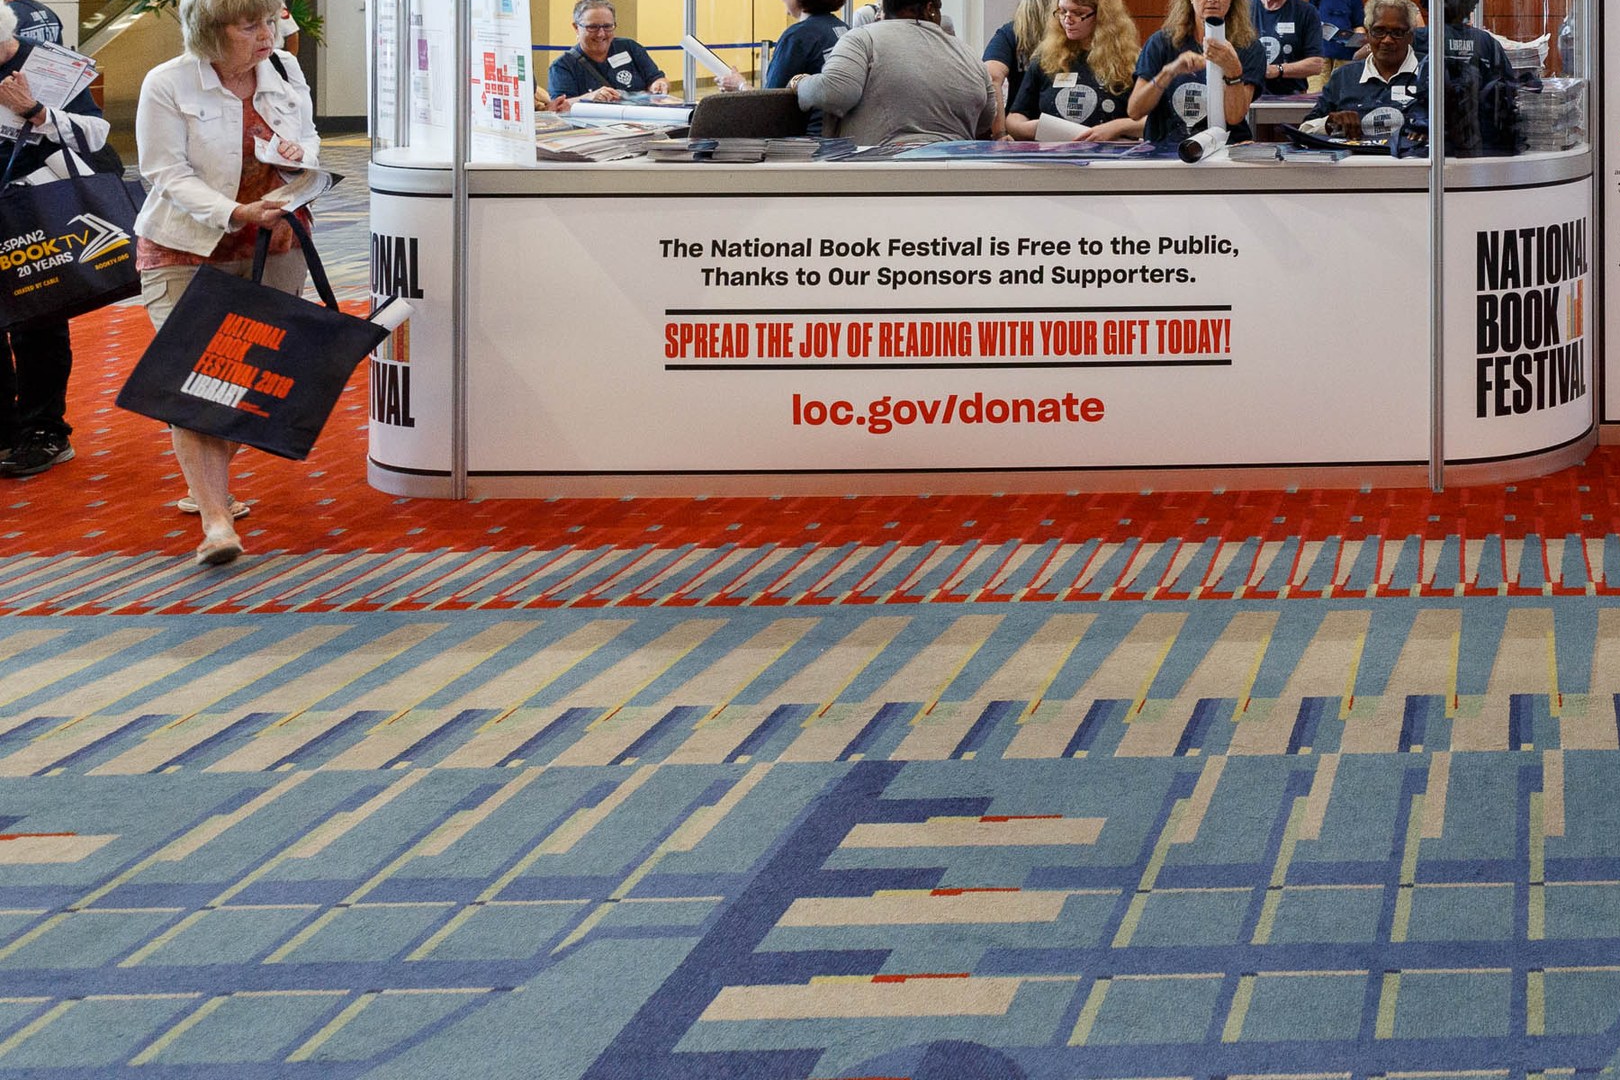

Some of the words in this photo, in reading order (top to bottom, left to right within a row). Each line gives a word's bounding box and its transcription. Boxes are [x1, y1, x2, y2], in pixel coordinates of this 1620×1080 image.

[17, 265, 32, 278] 20
[32, 252, 74, 272] YEARS
[660, 239, 703, 257] The
[712, 238, 812, 257] National
[820, 238, 880, 256] Book
[888, 237, 982, 256] Festival
[990, 237, 1009, 256] is
[1018, 238, 1070, 255] Free
[1078, 238, 1102, 255] to
[1110, 236, 1150, 254] the
[1159, 235, 1238, 257] Public,
[1476, 217, 1588, 291] NATIONAL
[13, 285, 35, 296] CREATED
[701, 267, 788, 286] Thanks
[796, 268, 820, 285] to
[829, 268, 870, 285] Our
[878, 267, 991, 290] Sponsors
[999, 266, 1044, 284] and
[1052, 266, 1195, 288] Supporters.
[219, 312, 287, 351] NATIONAL
[665, 323, 749, 358] SPREAD
[756, 323, 793, 358] THE
[800, 323, 841, 358] JOY
[848, 322, 873, 357] OF
[879, 322, 972, 357] READING
[978, 322, 1034, 356] WITH
[1040, 321, 1097, 356] YOUR
[1104, 320, 1149, 355] GIFT
[1156, 319, 1232, 355] TODAY!
[1476, 285, 1561, 356] BOOK
[205, 331, 253, 361] BOOK
[193, 351, 260, 389] FESTIVAL
[1476, 339, 1586, 419] FESTIVAL
[180, 371, 249, 408] LIBRARY
[793, 392, 1104, 434] loc.gov/donate
